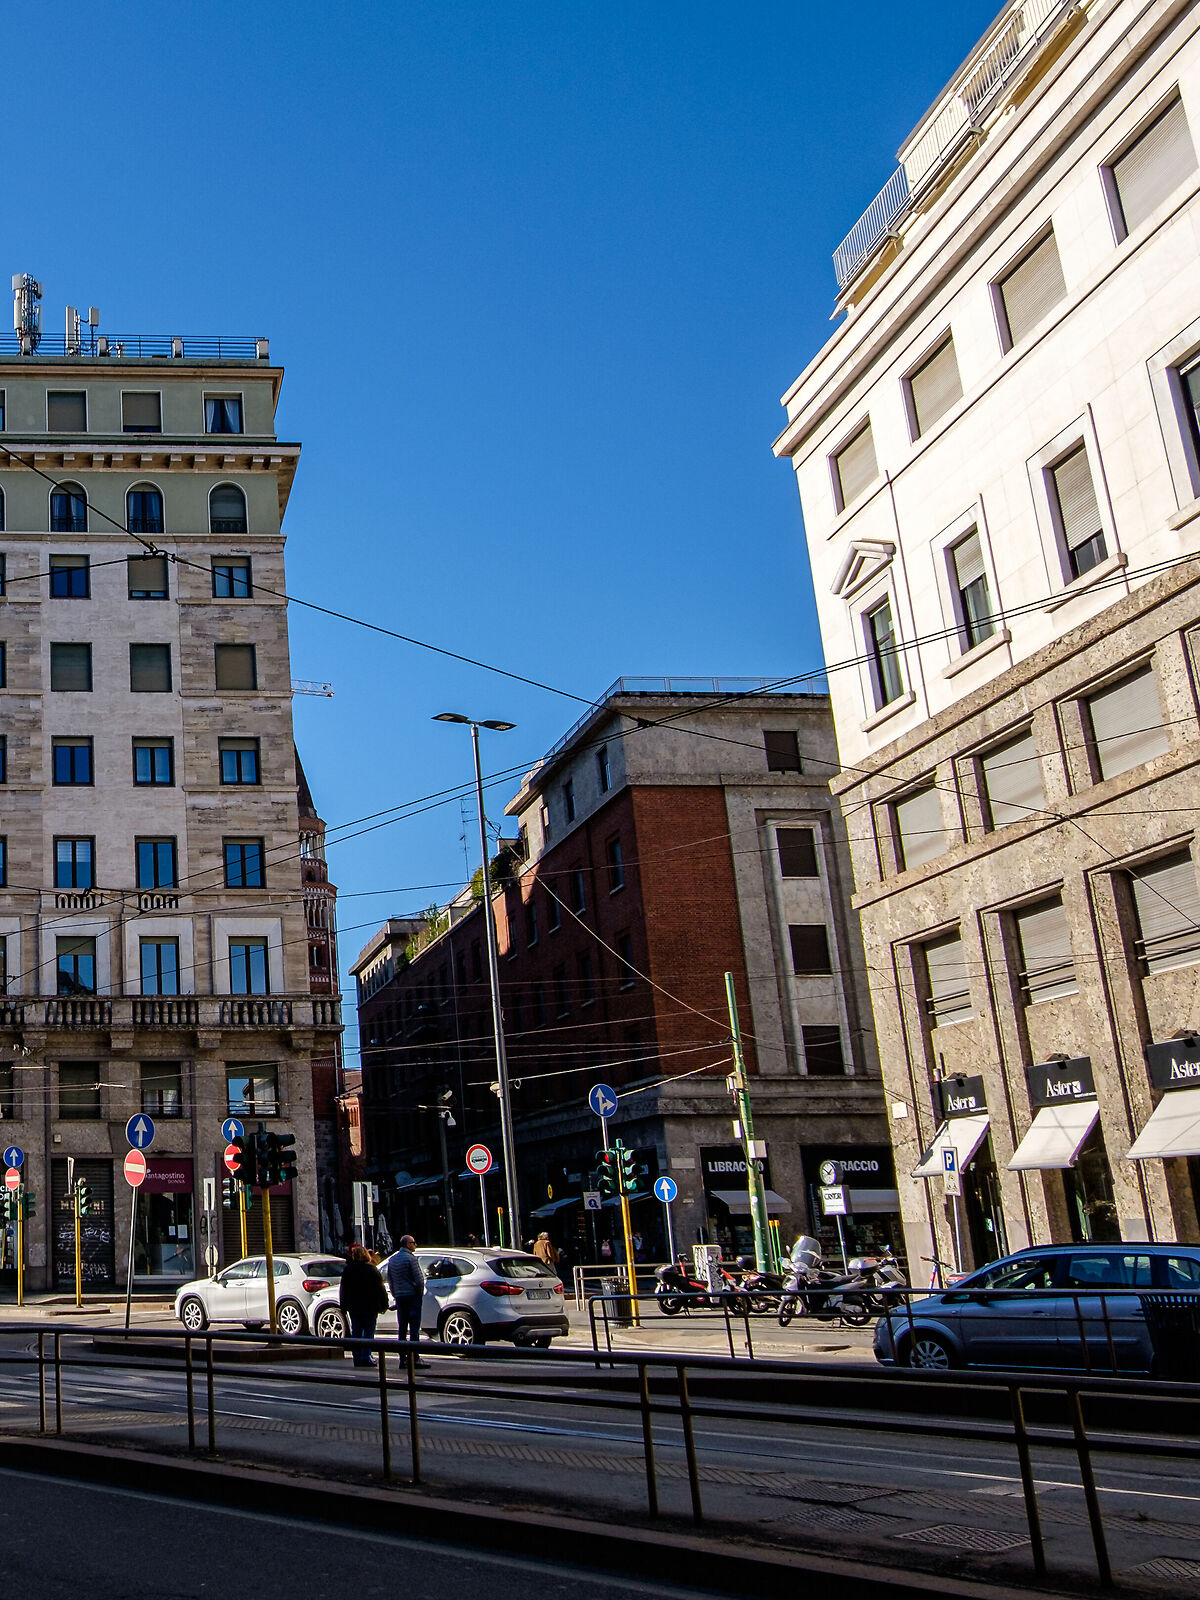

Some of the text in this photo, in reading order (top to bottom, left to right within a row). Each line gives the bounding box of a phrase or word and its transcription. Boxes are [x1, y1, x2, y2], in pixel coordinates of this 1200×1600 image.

[1170, 1058, 1200, 1080] Aster
[1046, 1078, 1072, 1097] Aster
[947, 1094, 968, 1111] Aster
[708, 1161, 764, 1172] LIBRACO
[839, 1160, 879, 1171] RACCIO
[945, 1152, 953, 1169] P
